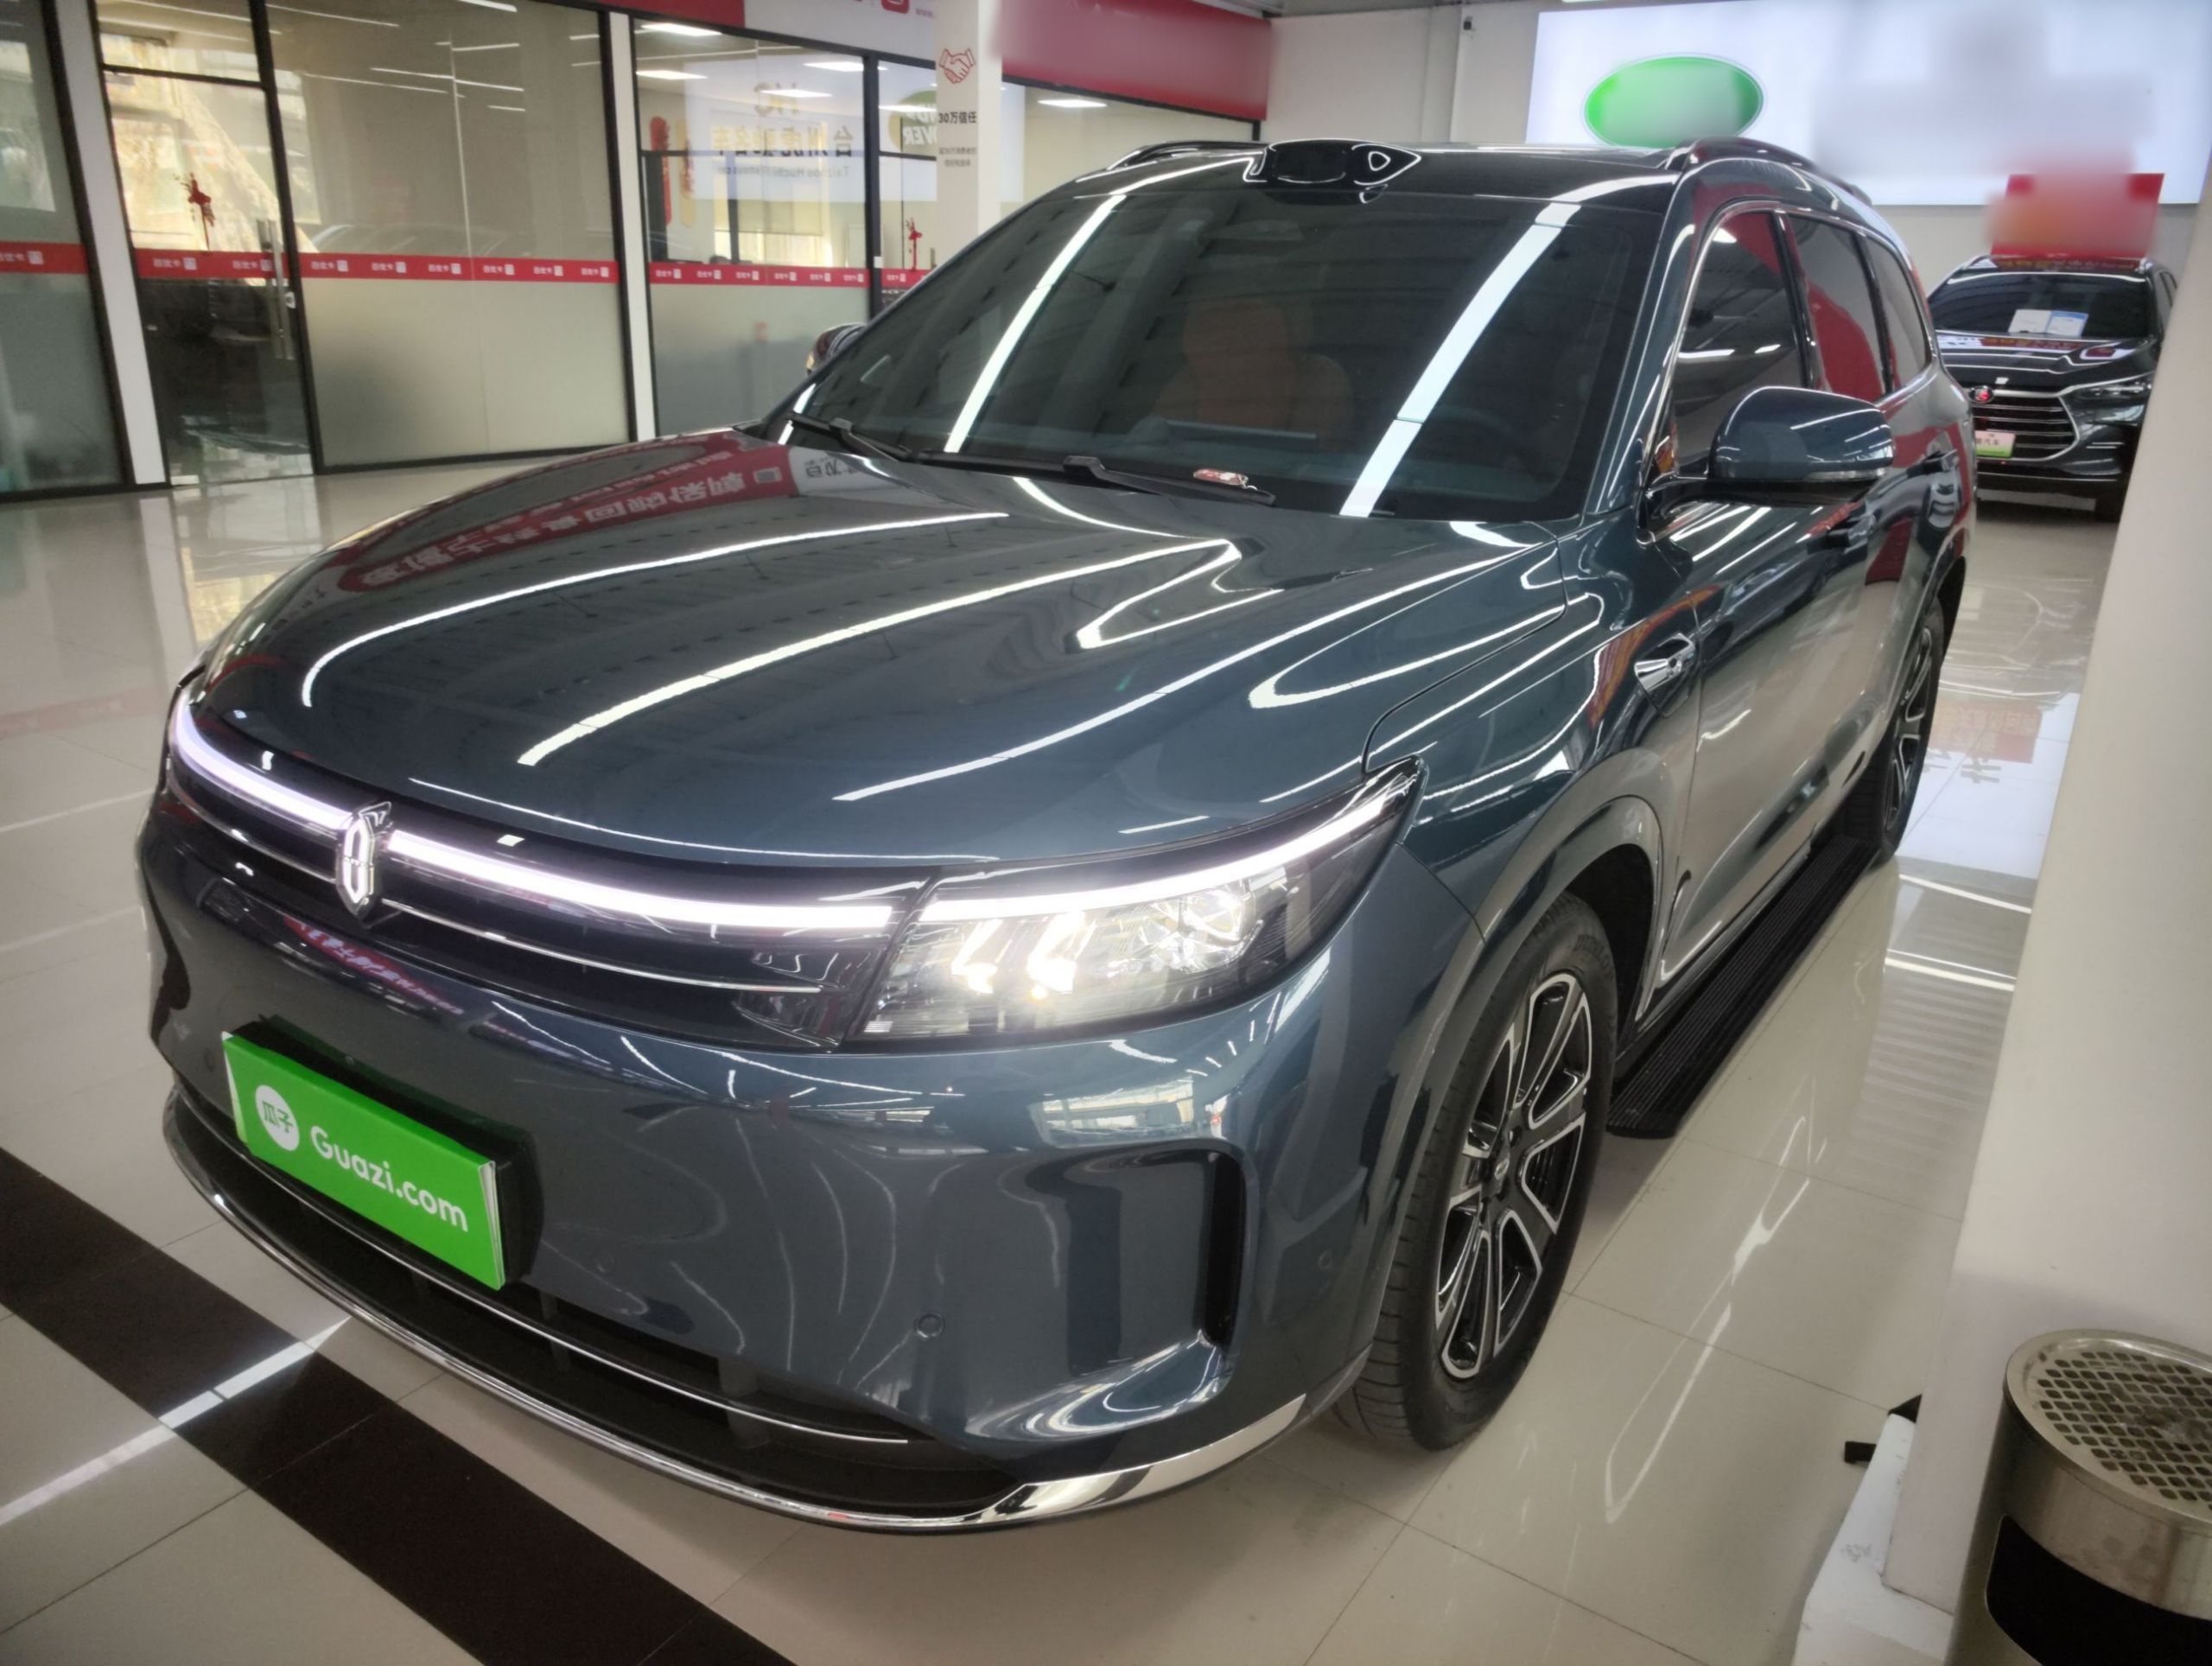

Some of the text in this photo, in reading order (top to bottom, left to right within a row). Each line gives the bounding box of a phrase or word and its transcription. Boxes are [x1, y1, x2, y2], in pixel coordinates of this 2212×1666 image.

[938, 111, 977, 124] 30万信任
[262, 1100, 294, 1134] 瓜子
[310, 1126, 468, 1232] Guazi.com
